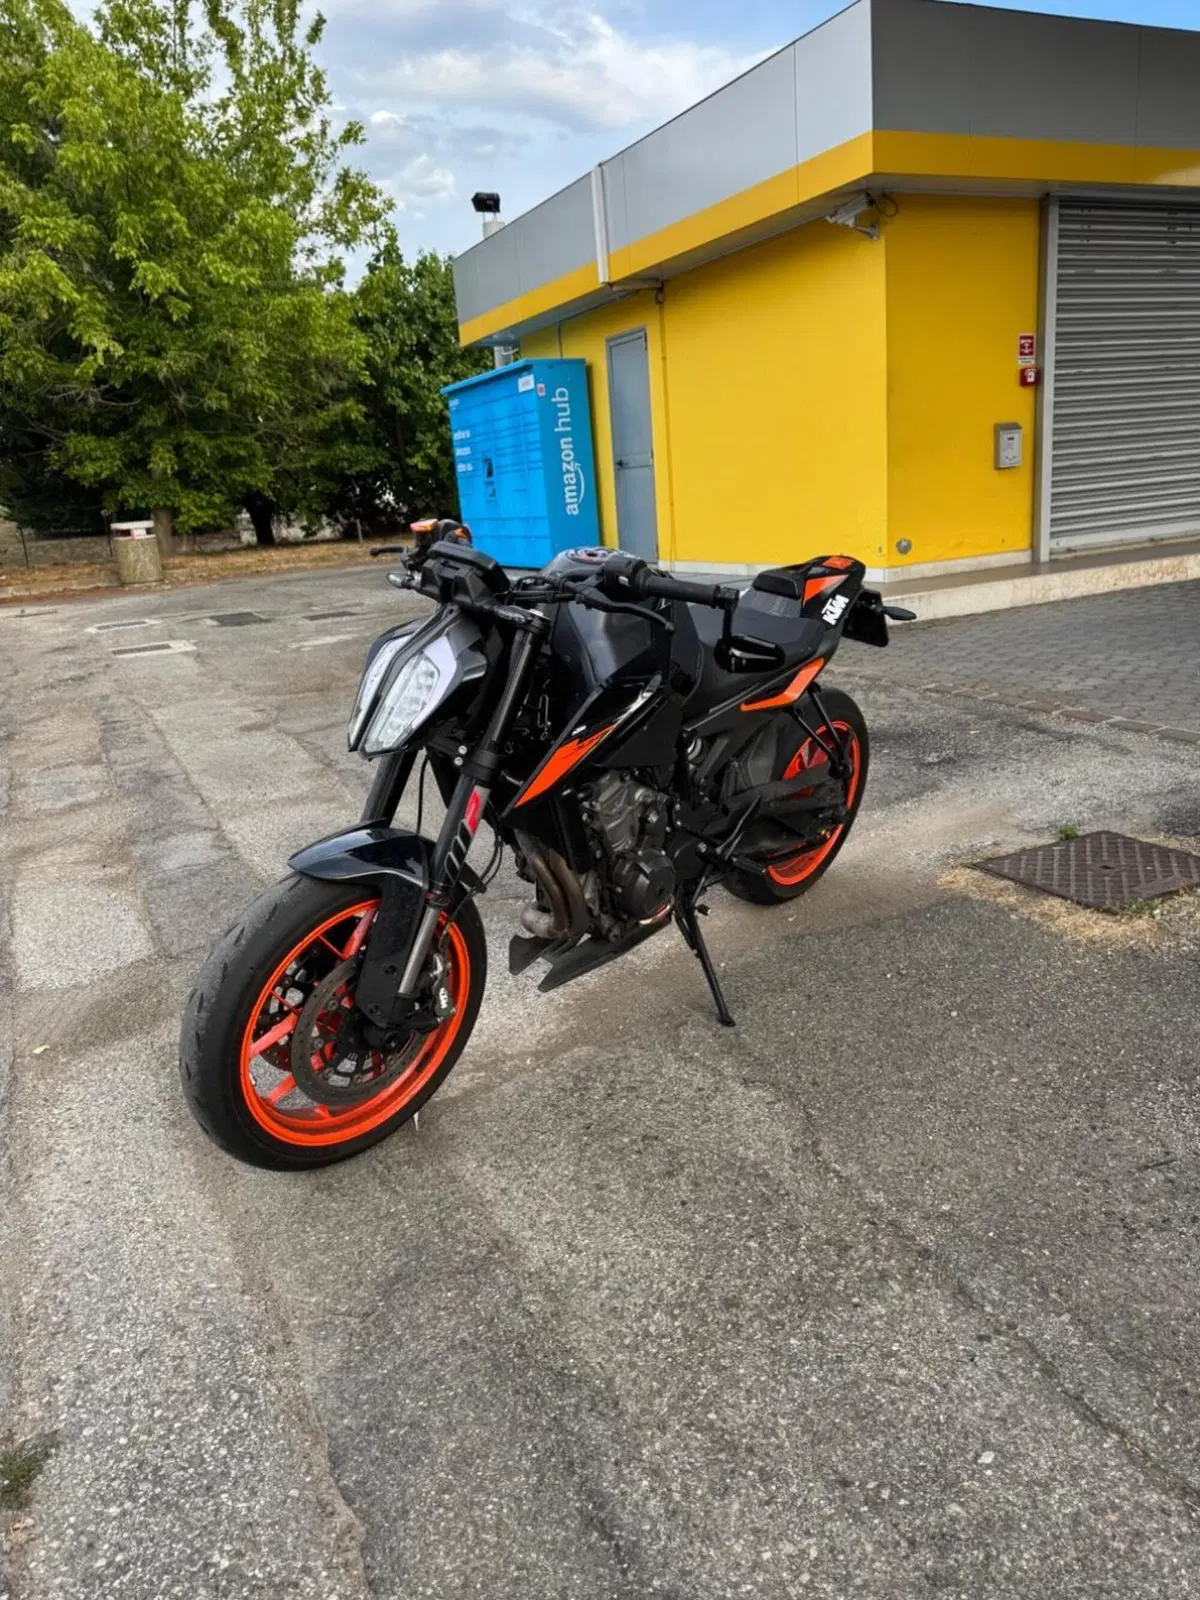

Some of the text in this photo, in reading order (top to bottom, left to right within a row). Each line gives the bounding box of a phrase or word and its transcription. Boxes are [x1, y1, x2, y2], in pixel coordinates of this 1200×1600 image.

[551, 387, 580, 516] amazon hub
[821, 594, 850, 626] KTM
